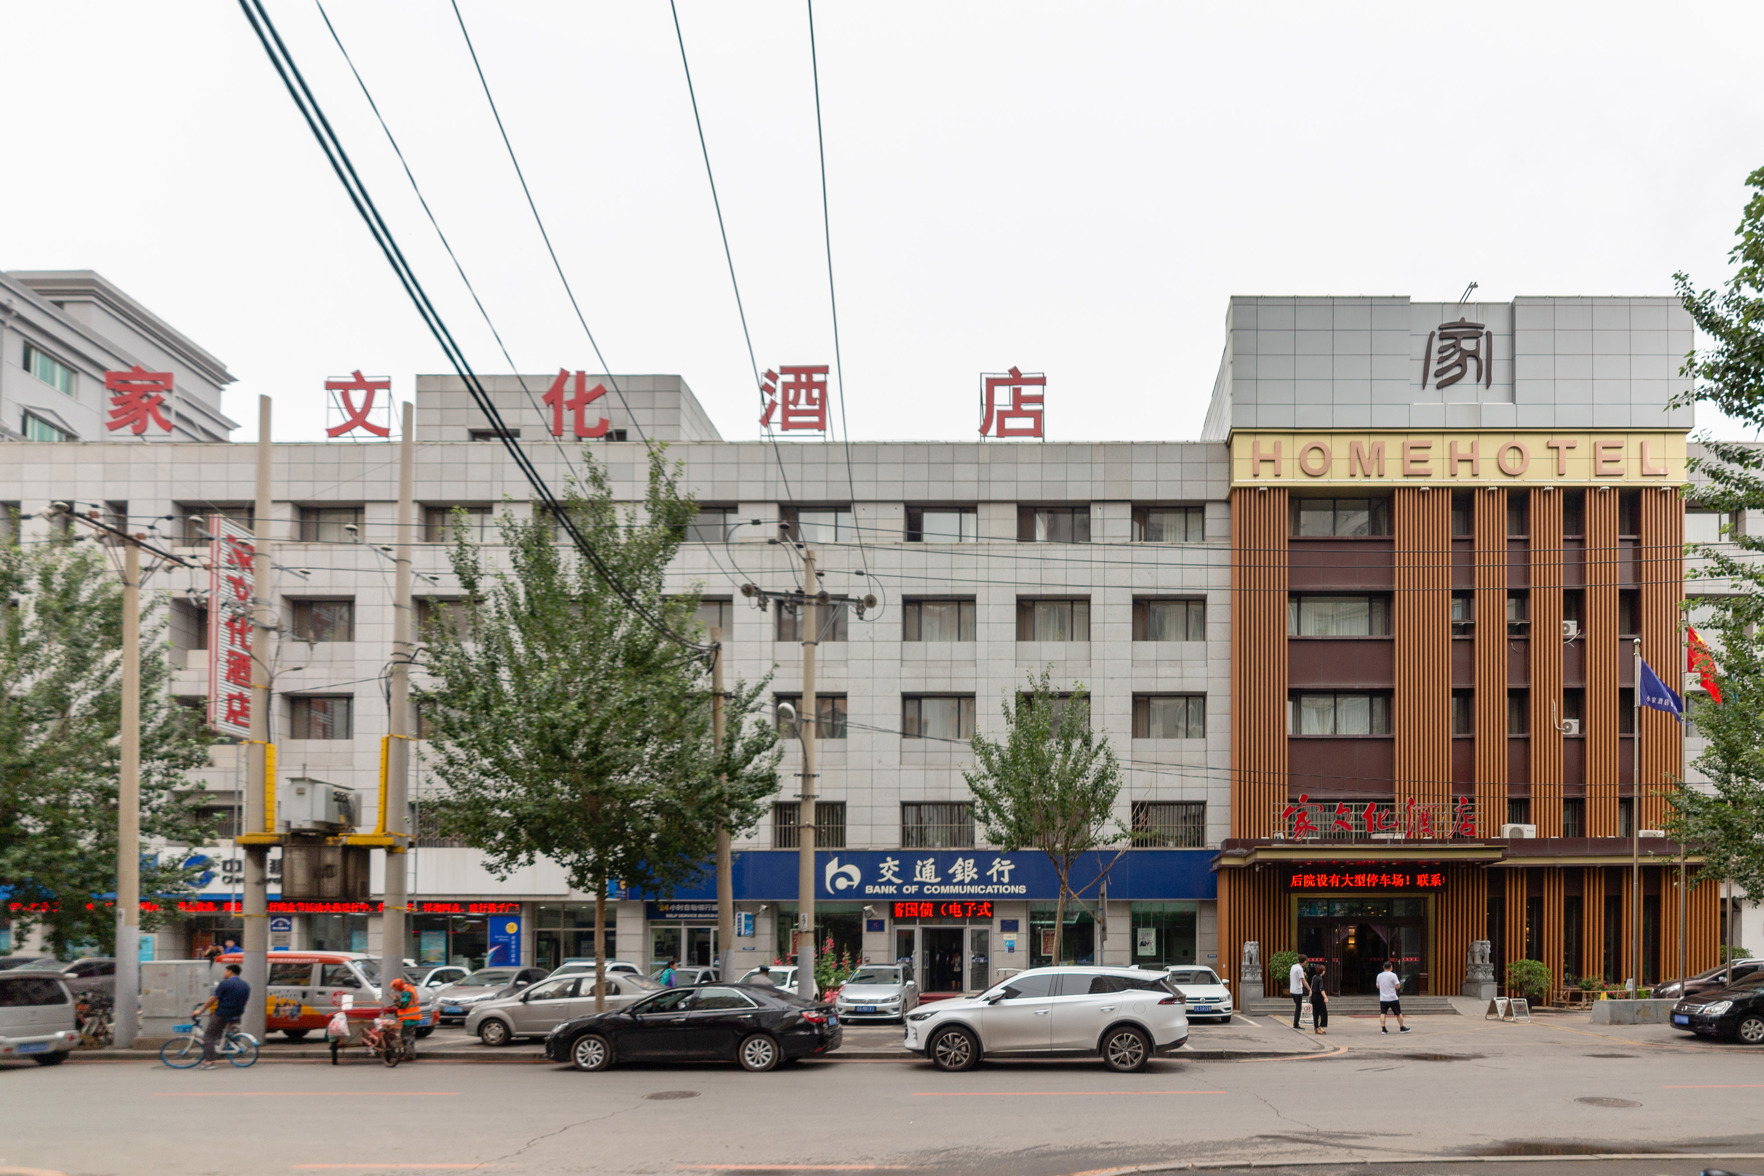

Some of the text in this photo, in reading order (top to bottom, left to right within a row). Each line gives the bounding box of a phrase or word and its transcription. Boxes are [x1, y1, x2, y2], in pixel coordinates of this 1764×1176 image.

[104, 365, 1047, 440] 家文化酒店
[1281, 793, 1477, 842] 家文化酒店
[865, 885, 1027, 894] BANK OF COMMUNICATIONS
[1290, 872, 1446, 888] 后院设有大型停车场！联系
